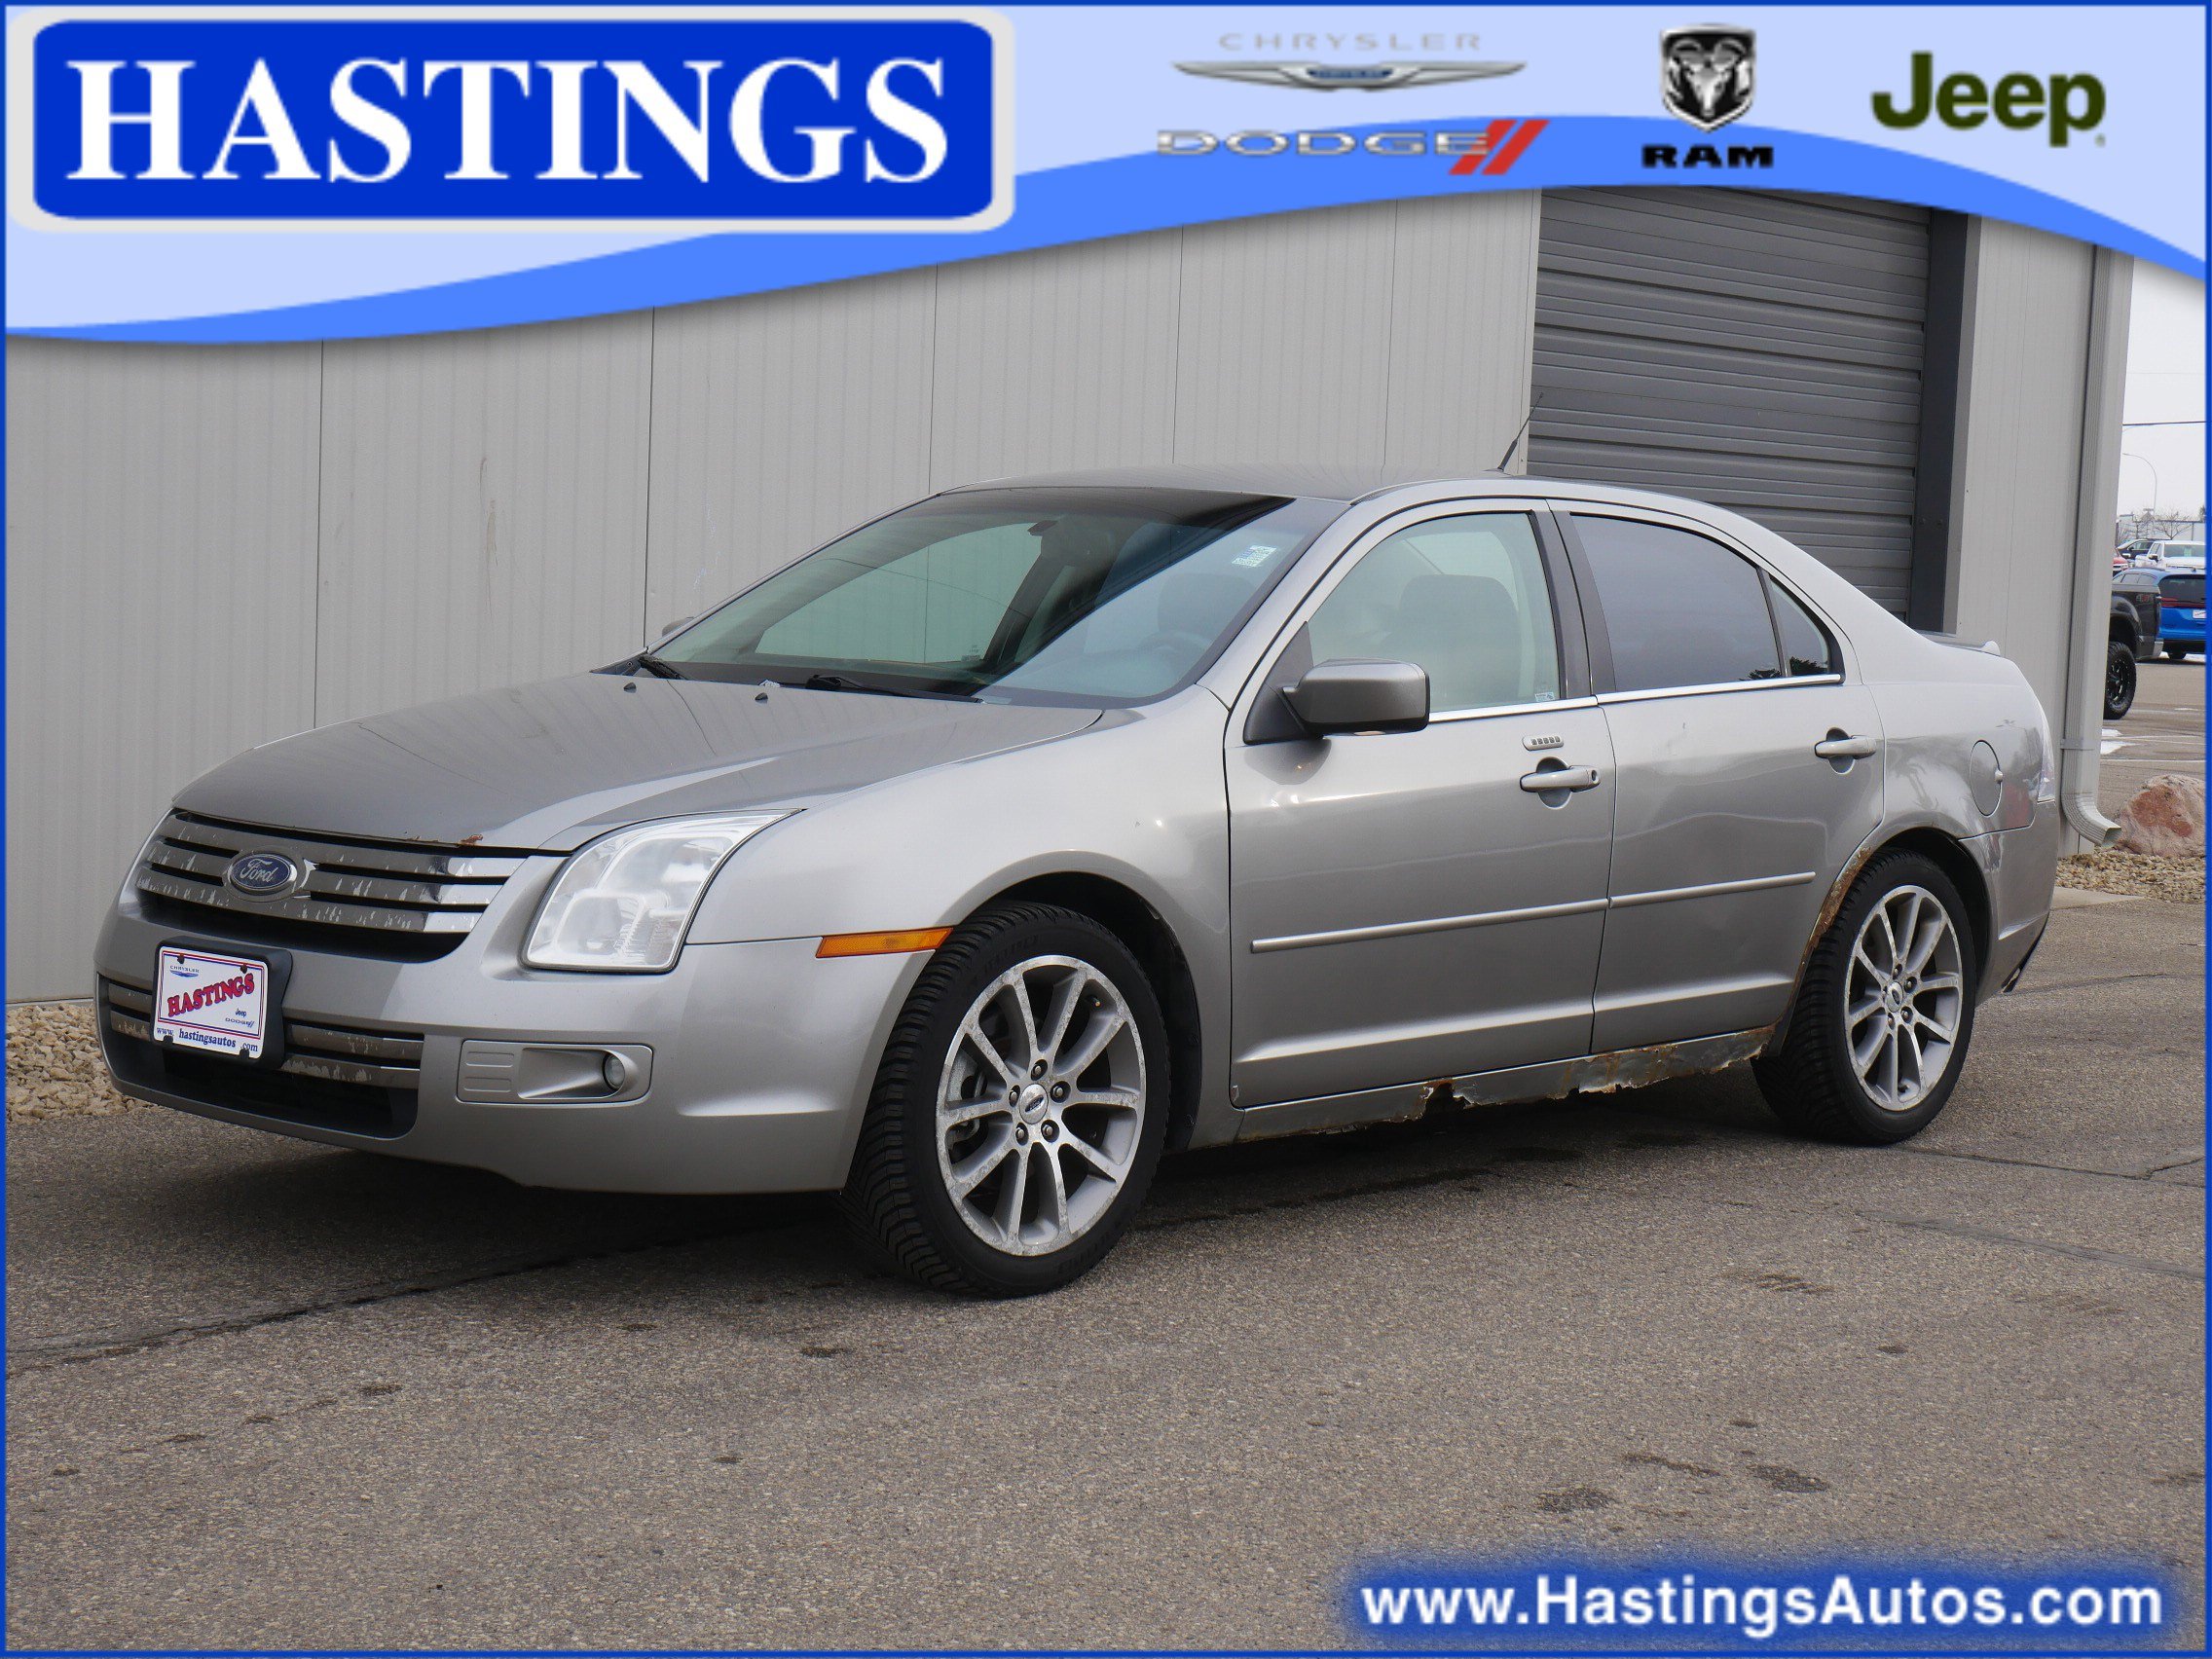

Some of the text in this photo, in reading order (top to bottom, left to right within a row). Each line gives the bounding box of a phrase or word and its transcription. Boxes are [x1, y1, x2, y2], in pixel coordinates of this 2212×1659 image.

[240, 858, 278, 882] Ford
[166, 973, 255, 1017] HASTINGS
[235, 1008, 246, 1017] Jeep
[178, 1028, 236, 1048] hastingsautos
